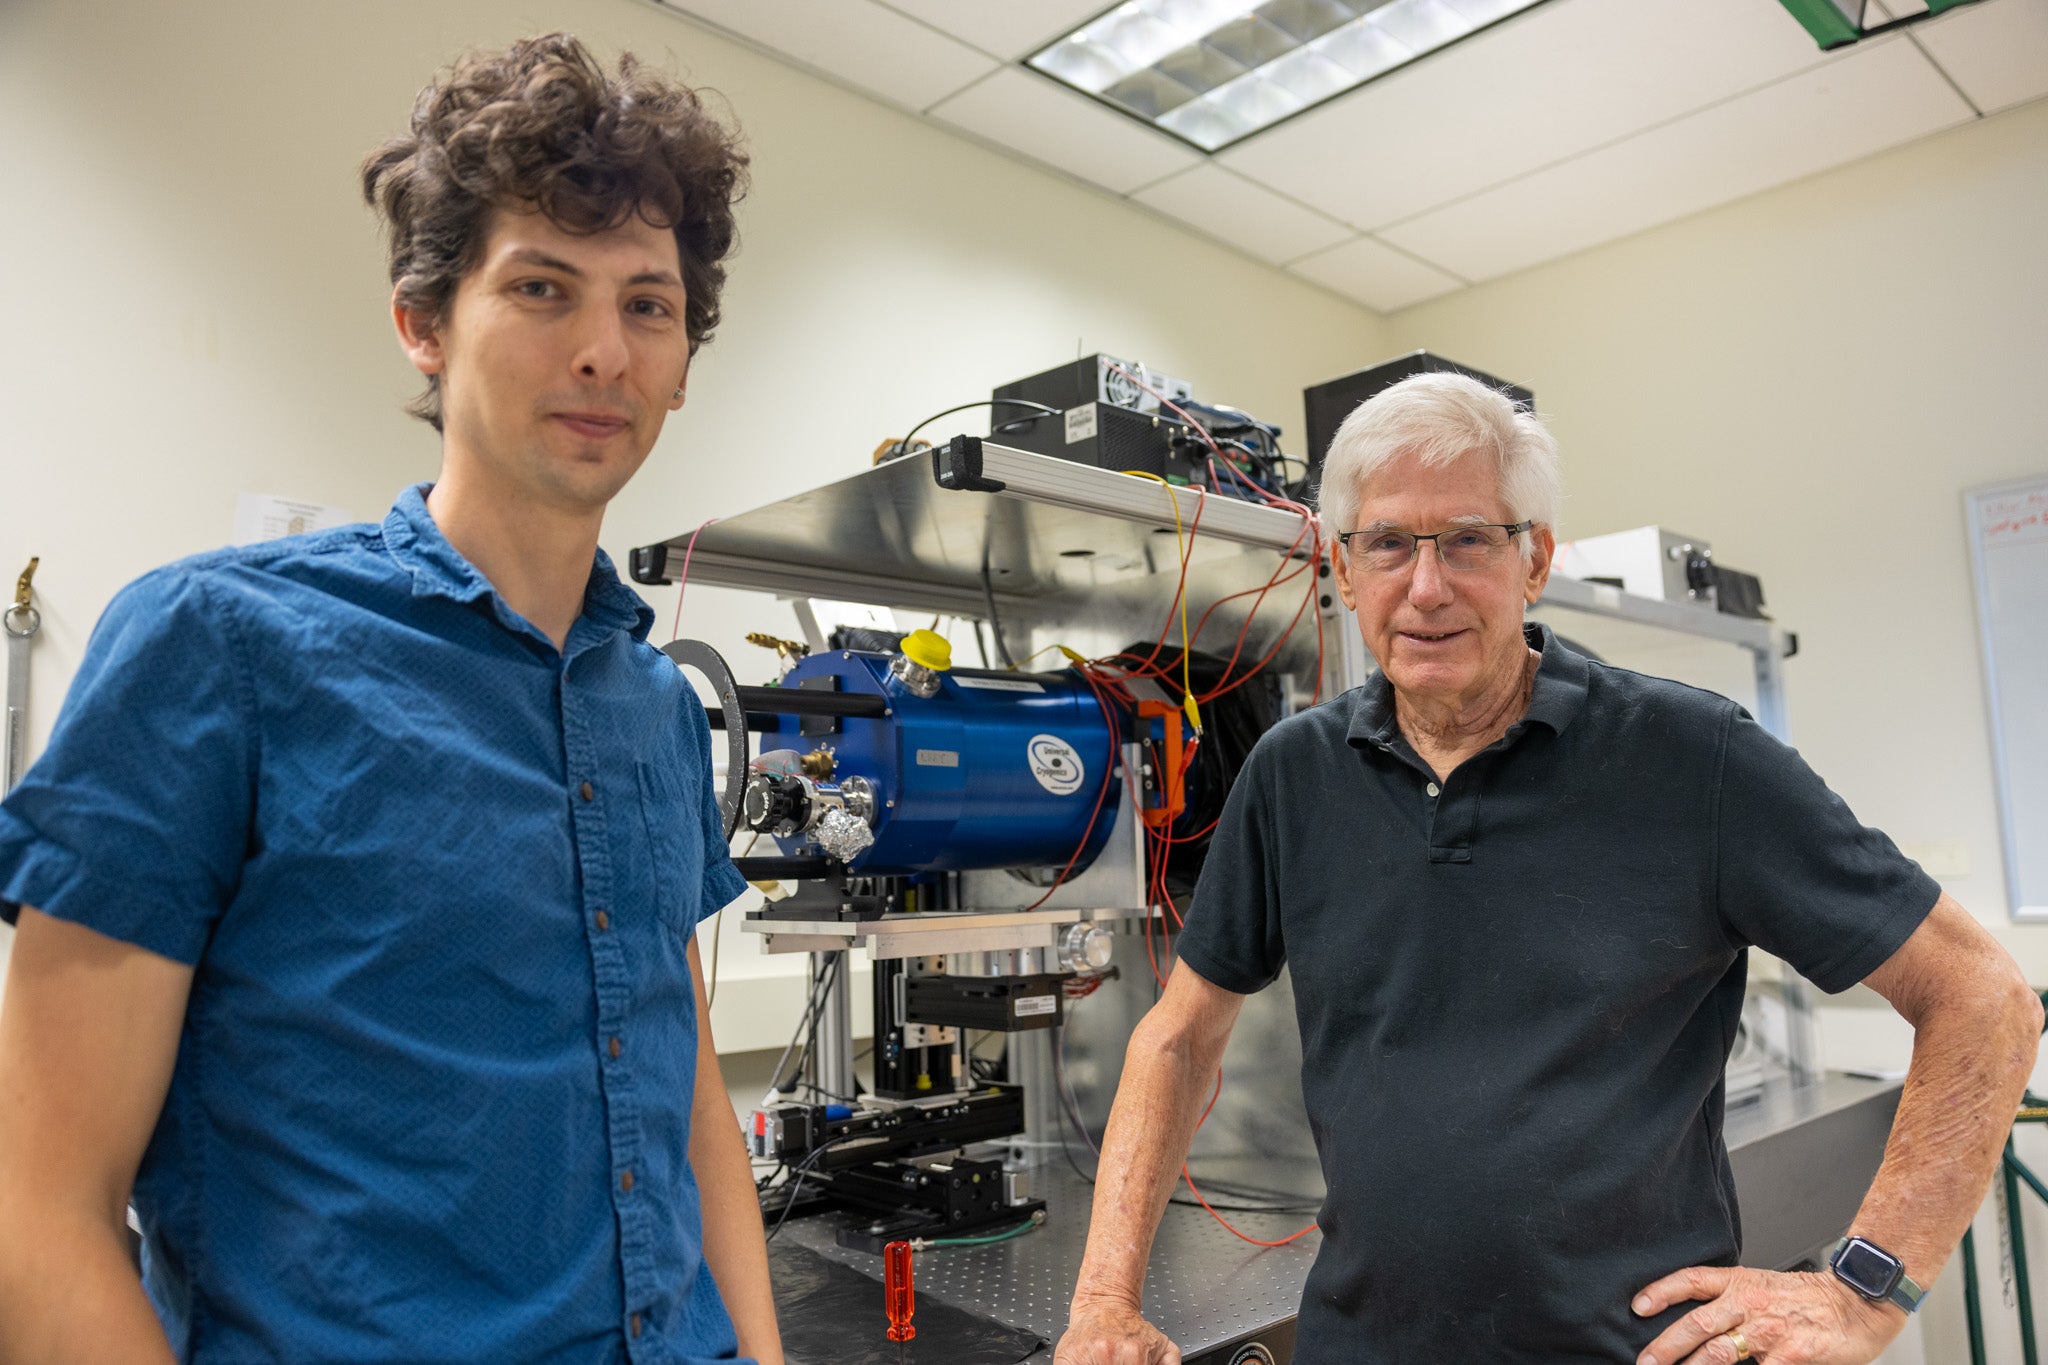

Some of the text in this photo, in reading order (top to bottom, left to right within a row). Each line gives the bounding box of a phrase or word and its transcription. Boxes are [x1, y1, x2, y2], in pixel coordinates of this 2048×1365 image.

[1043, 747, 1070, 756] Universal
[1036, 766, 1067, 777] Cryogenics
[1234, 1351, 1249, 1365] ATION
